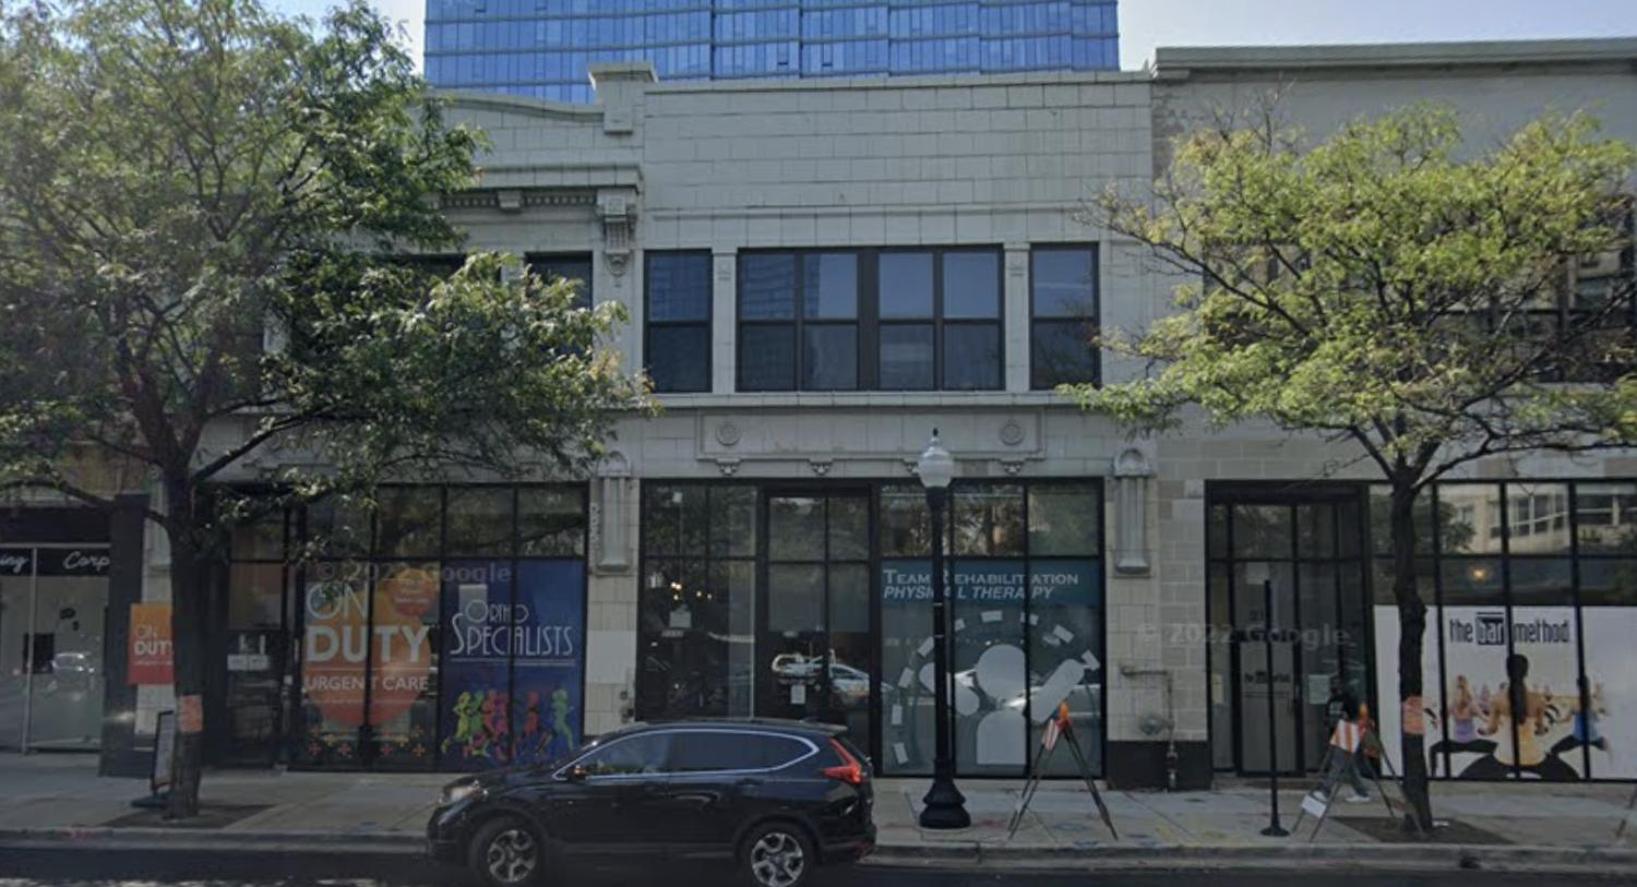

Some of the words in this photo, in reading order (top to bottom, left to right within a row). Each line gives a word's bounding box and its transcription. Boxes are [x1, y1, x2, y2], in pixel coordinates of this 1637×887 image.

[882, 569, 931, 585] TEAM
[305, 582, 370, 620] ON
[971, 586, 1054, 599] THERAPY
[450, 613, 573, 656] SPECIALISTS
[1450, 618, 1473, 643] the
[1512, 618, 1570, 643] method
[305, 625, 430, 662] DUTY
[303, 675, 380, 691] URGENT
[382, 675, 429, 691] CARE
